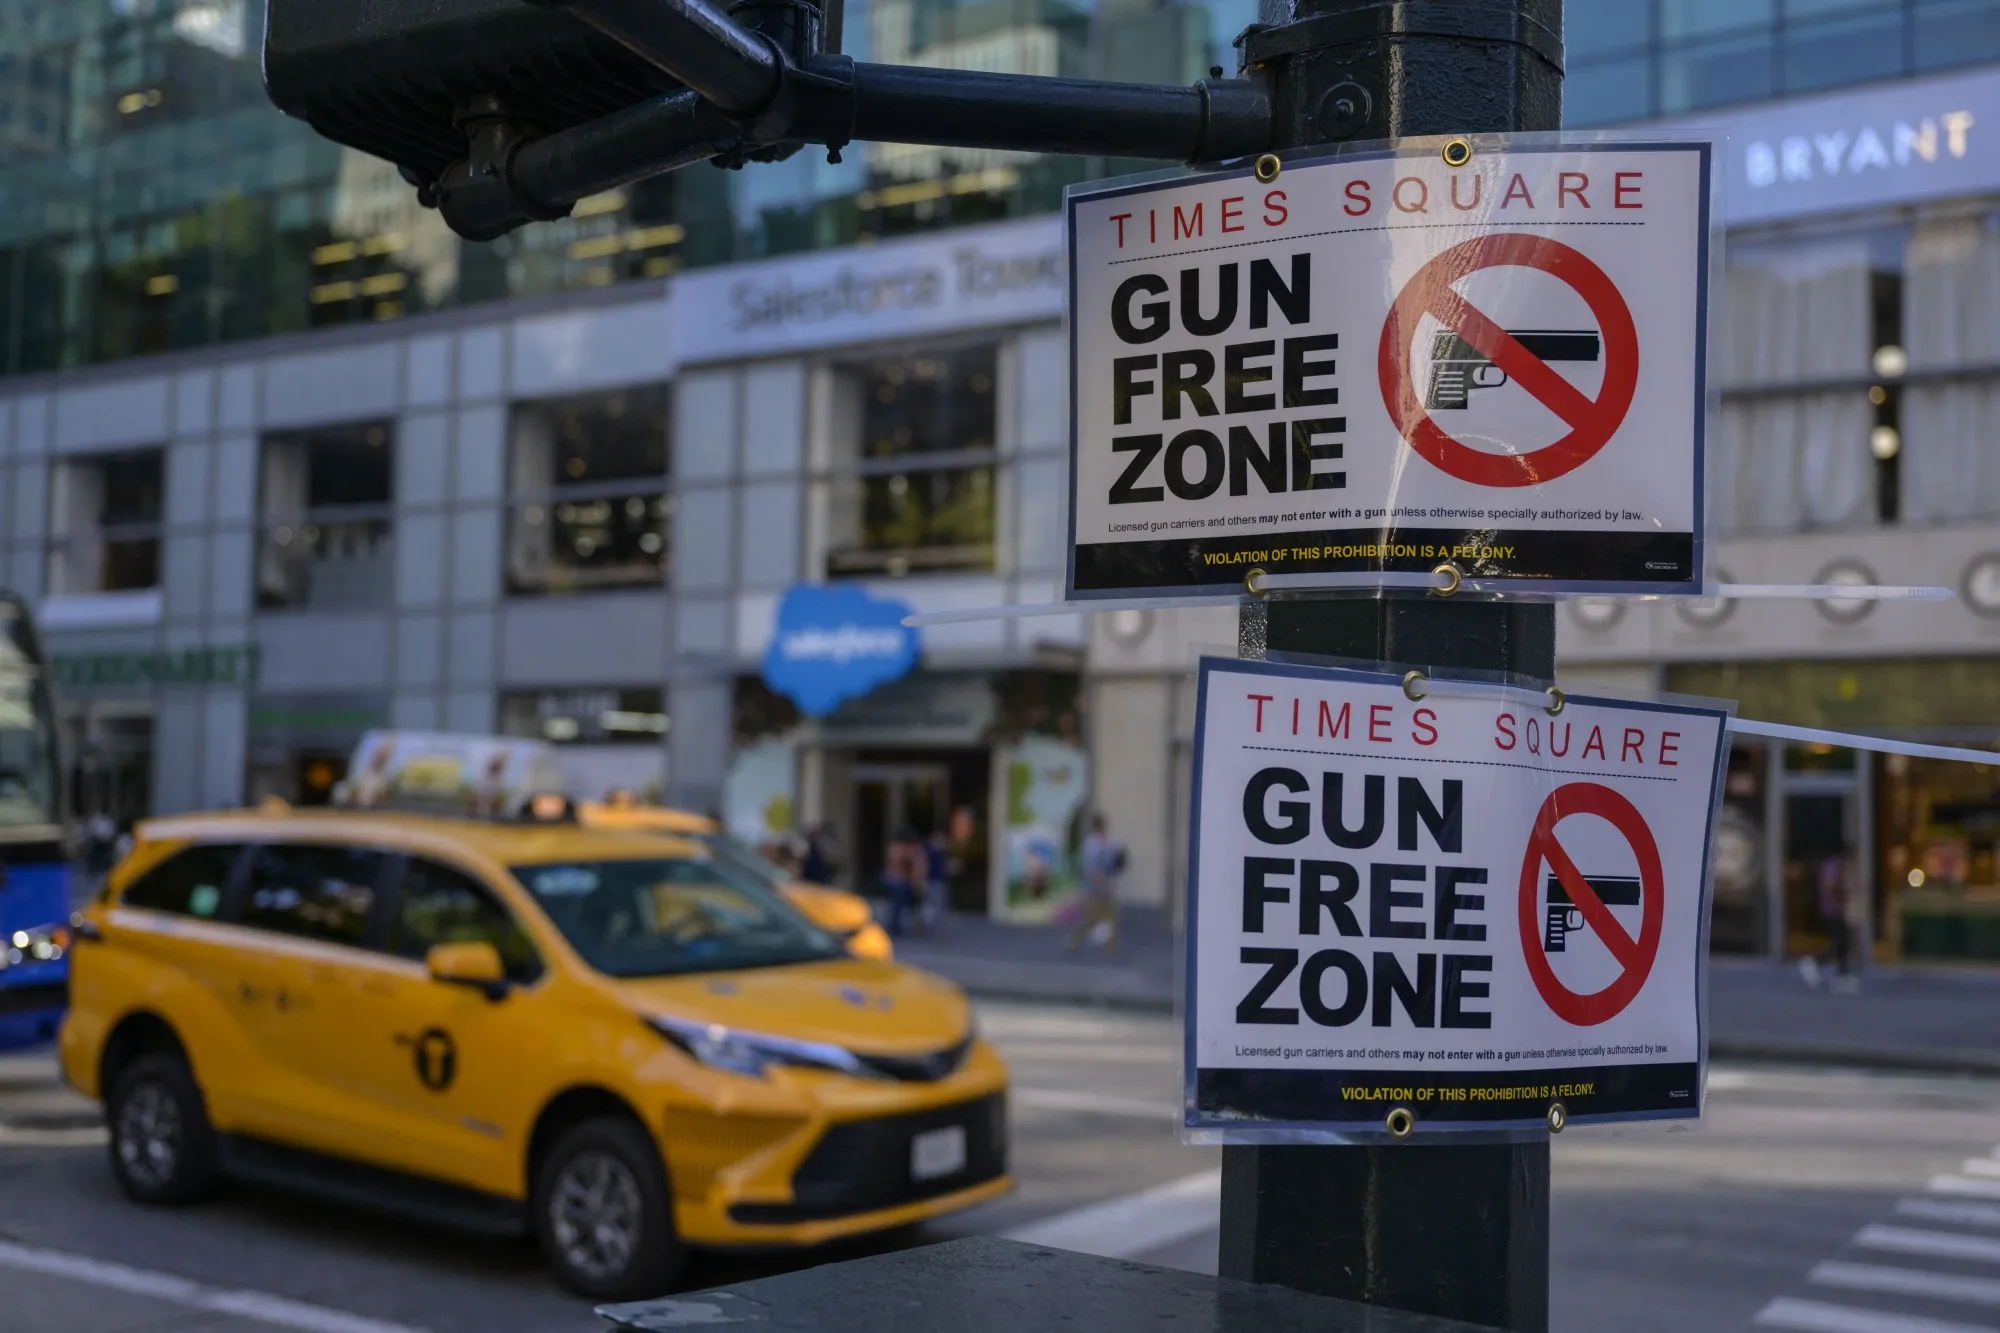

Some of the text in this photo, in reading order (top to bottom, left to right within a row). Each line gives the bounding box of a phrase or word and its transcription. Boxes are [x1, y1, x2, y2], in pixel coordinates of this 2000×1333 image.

[1745, 110, 1975, 188] BRYANT
[1109, 171, 1644, 249] TIMES SQUARE
[1110, 252, 1311, 344] GUN
[1113, 333, 1339, 425] FREE
[1108, 417, 1347, 505] ZONE
[1108, 507, 1645, 534] Licensed gun carriers and others may not enter with a gun unless otherwise specially authorized by law.
[1204, 544, 1517, 566] VIOLATION OF THIS PROHIBITION IS A FELONY.
[1247, 694, 1681, 766] TIMES SQUARE
[1242, 767, 1463, 853] GUN
[1243, 856, 1488, 942] FREE
[1235, 947, 1493, 1029] ZONE
[1235, 1044, 1669, 1062] Licensed gun carriers and others may not enter with a gun unless otherwise specially authorized by law.
[1341, 1083, 1596, 1101] VIOLATION OF THIS PROHIBITION IS A FELONY.
